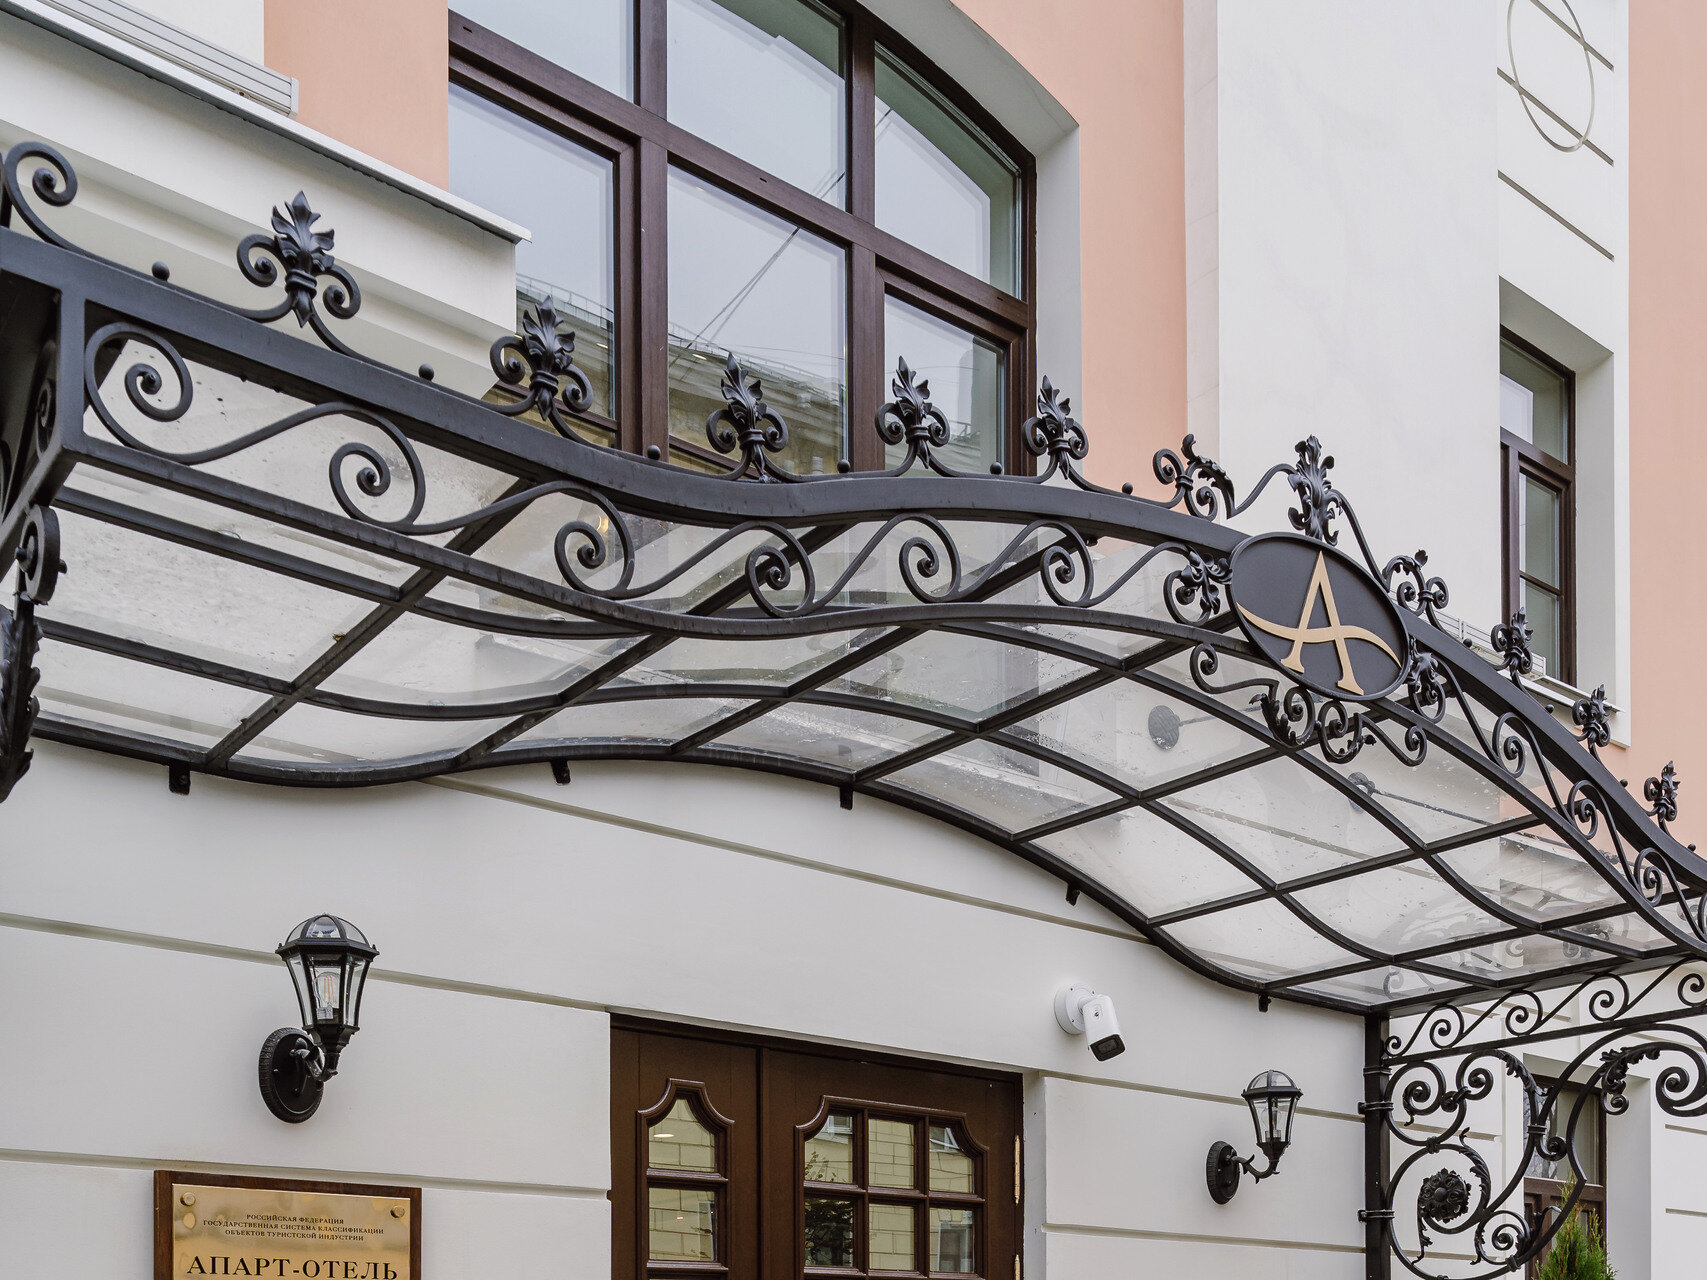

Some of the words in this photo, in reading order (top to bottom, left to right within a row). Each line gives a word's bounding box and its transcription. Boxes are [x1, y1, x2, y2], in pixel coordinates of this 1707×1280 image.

[246, 1214, 297, 1222] РОССИЙСКАЯ
[298, 1216, 344, 1225] ФЕДЕРАЦИЯ
[203, 1219, 279, 1229] ГОСУДАРСТВЕННАЯ
[280, 1223, 316, 1231] СИСТЕМА
[318, 1225, 384, 1234] КЛАССИФИКАЦИИ
[225, 1229, 265, 1237] ОБЪЕКТОВ
[267, 1231, 317, 1239] ТУРИСТСКОЙ
[318, 1233, 364, 1241] ИНДУСТРИИ
[187, 1255, 398, 1280] АПАРТ-ОТЕЛЬ
